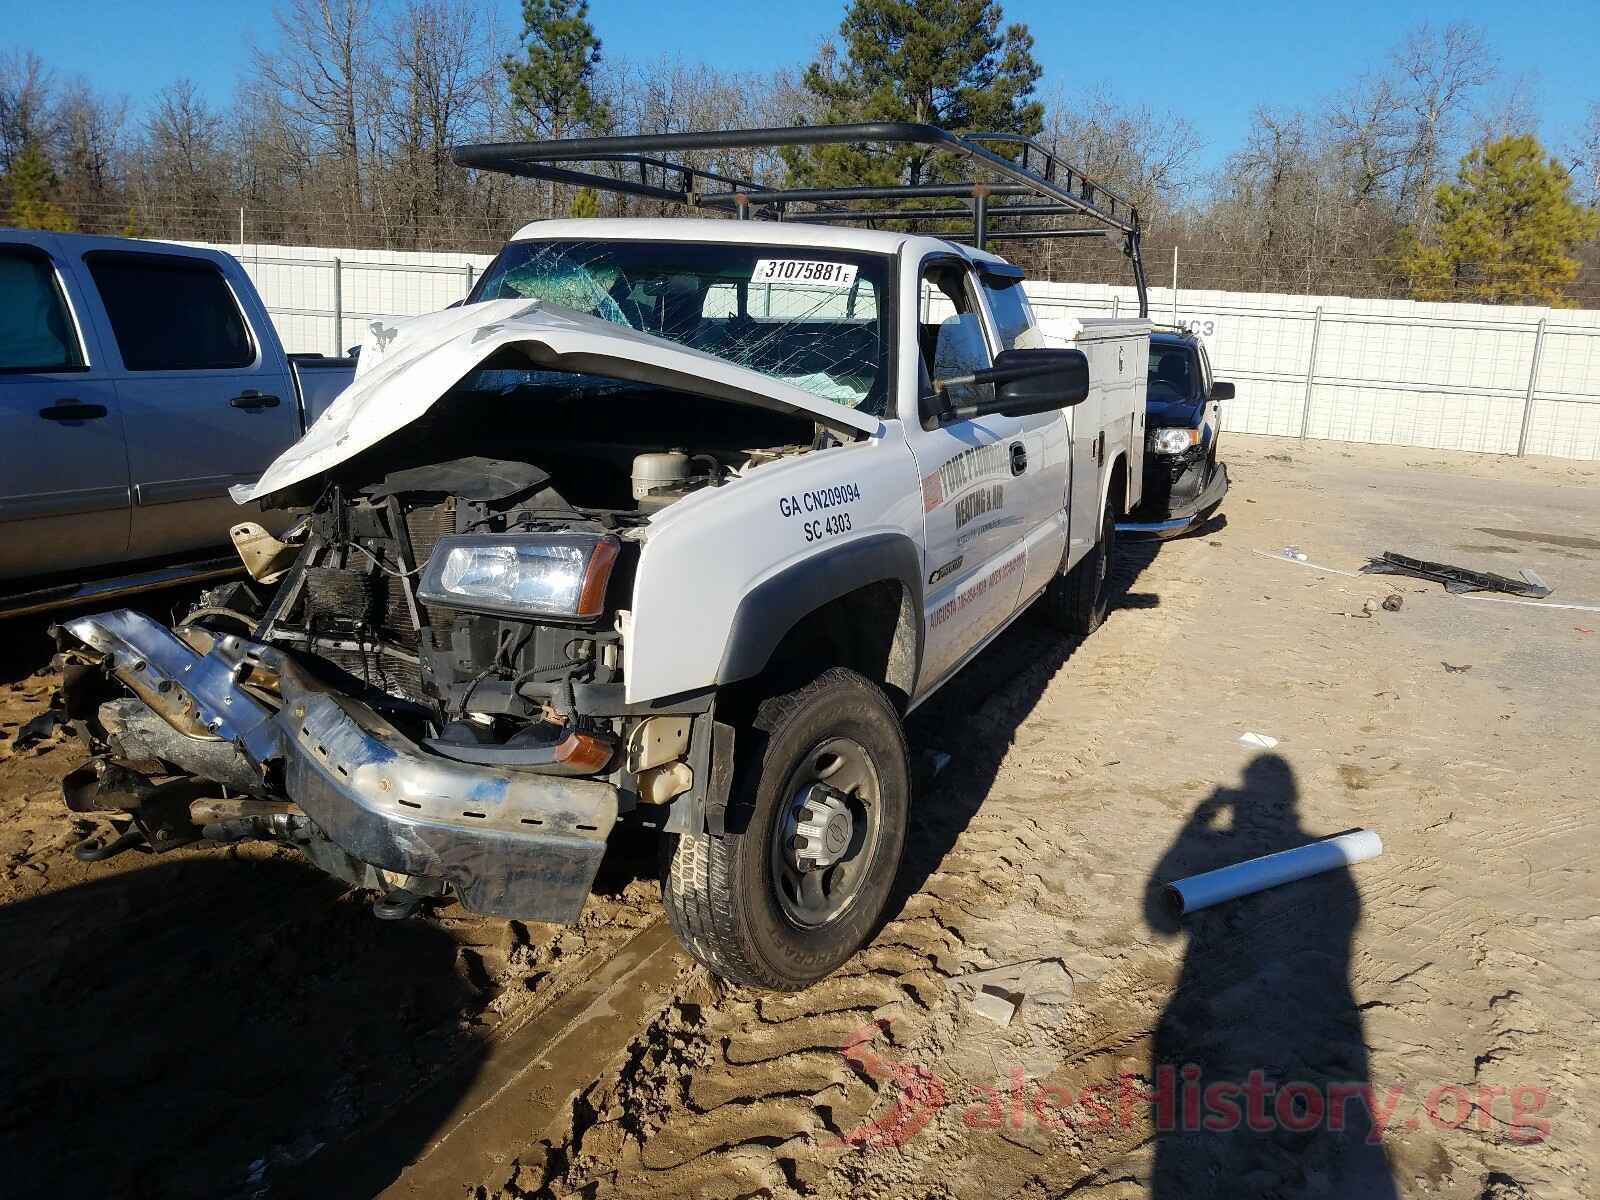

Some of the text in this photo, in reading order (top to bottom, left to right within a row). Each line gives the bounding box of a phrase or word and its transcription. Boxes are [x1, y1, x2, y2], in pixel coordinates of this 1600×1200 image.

[765, 261, 842, 282] 31075881
[843, 273, 850, 283] E
[779, 482, 861, 517] GA CN209094
[803, 512, 852, 542] SC 4303
[929, 598, 957, 632] AUGUSTA
